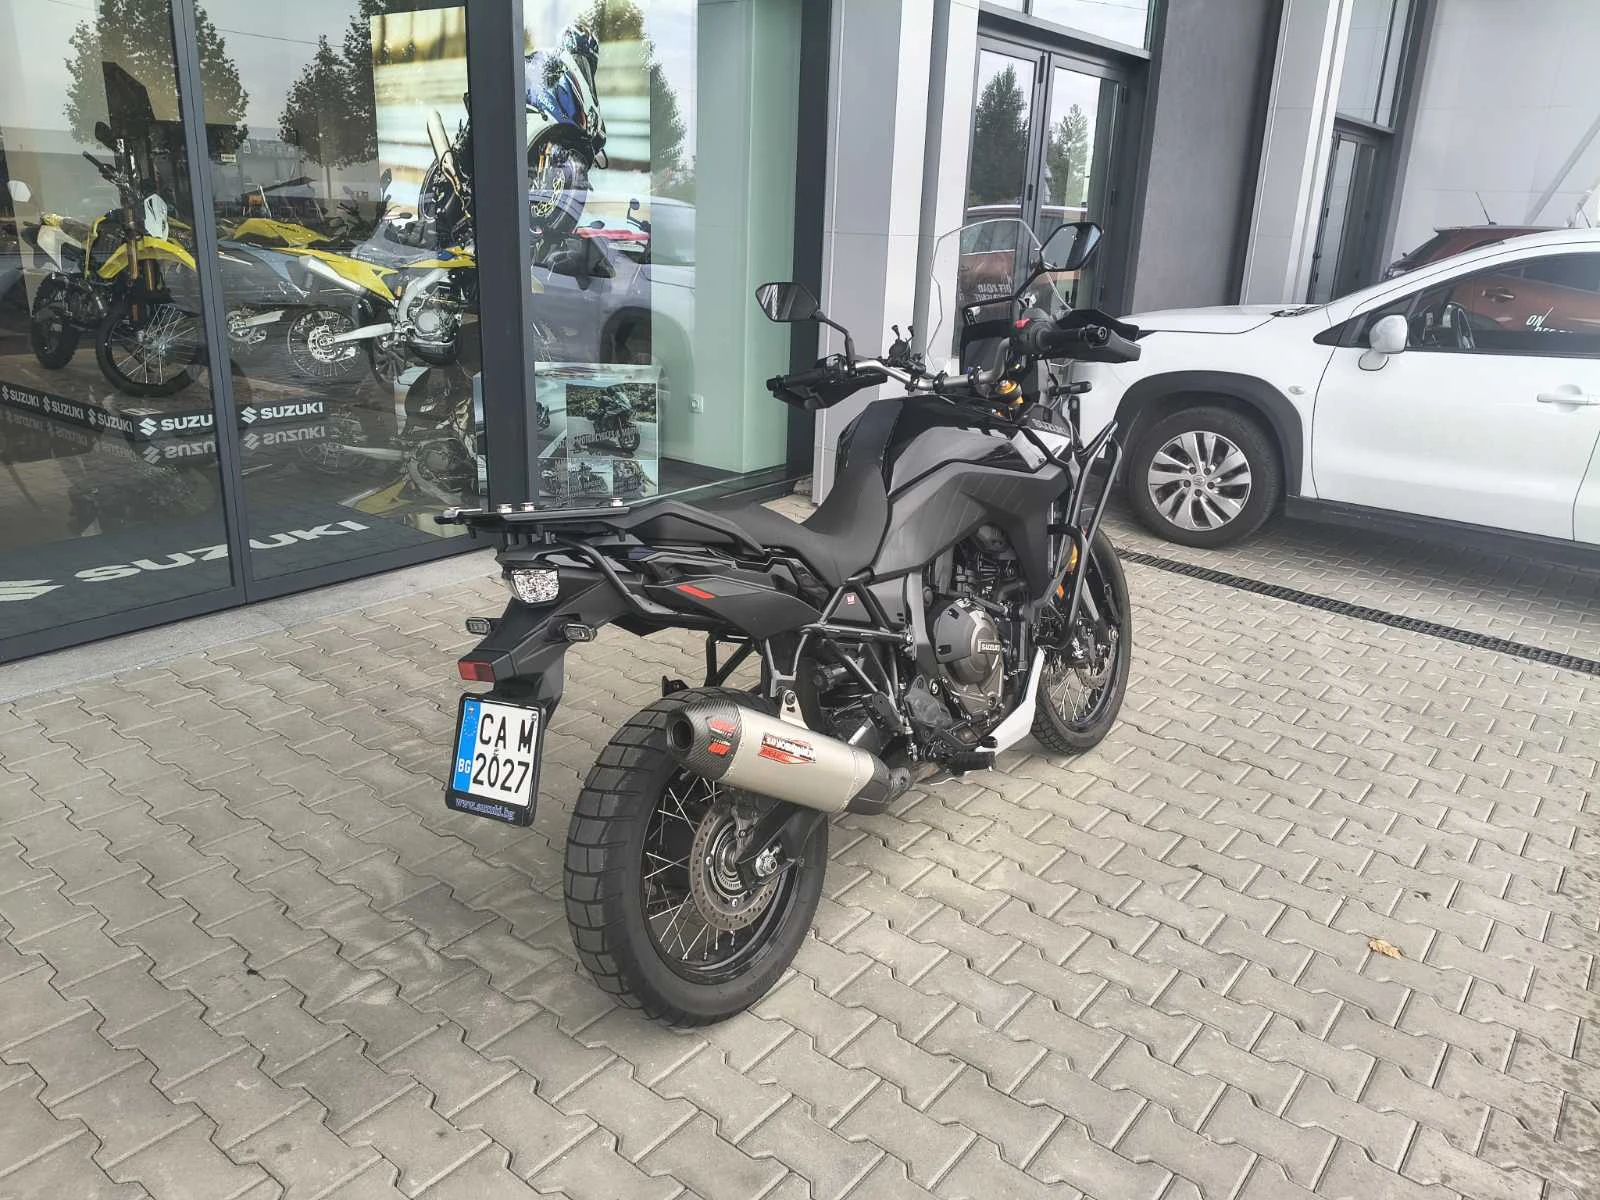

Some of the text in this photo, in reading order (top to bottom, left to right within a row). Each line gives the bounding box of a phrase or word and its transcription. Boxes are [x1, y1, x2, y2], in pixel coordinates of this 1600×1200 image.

[9, 389, 40, 407] SUZUKI
[51, 401, 84, 420] SUZUKI
[260, 402, 323, 419] SUZUKI
[97, 412, 134, 433] SUZUKI
[160, 414, 213, 431] SUZU
[74, 520, 370, 583] SUZUKI
[479, 713, 535, 754] CA M
[458, 758, 472, 774] BG
[472, 753, 530, 794] 2027
